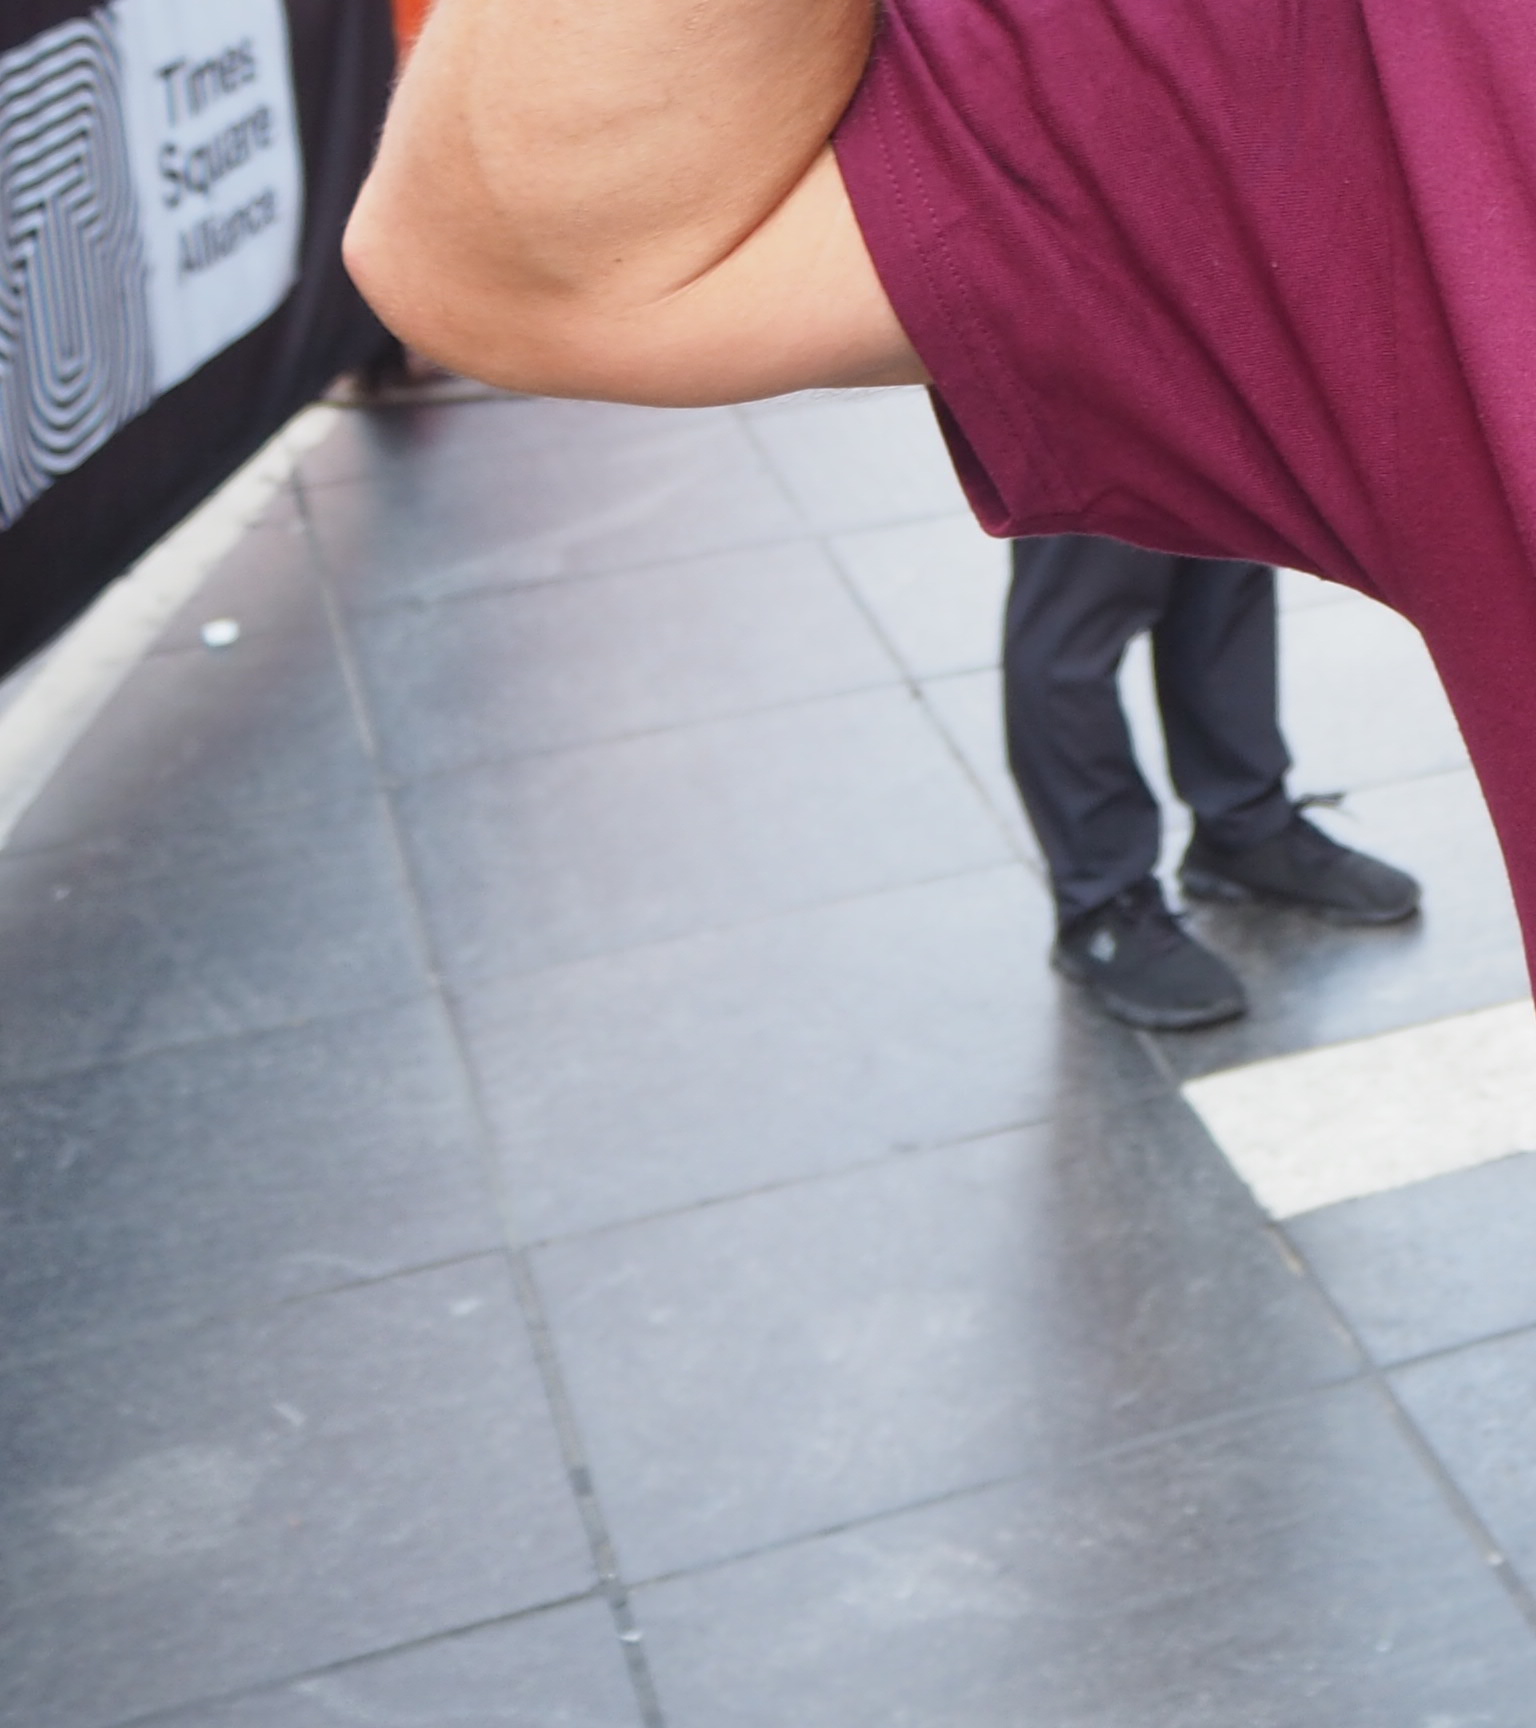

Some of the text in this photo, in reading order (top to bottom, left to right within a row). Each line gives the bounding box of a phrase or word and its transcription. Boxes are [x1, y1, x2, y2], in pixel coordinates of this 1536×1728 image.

[157, 38, 257, 125] Times
[159, 104, 273, 208] Square
[179, 190, 275, 276] Alliance
